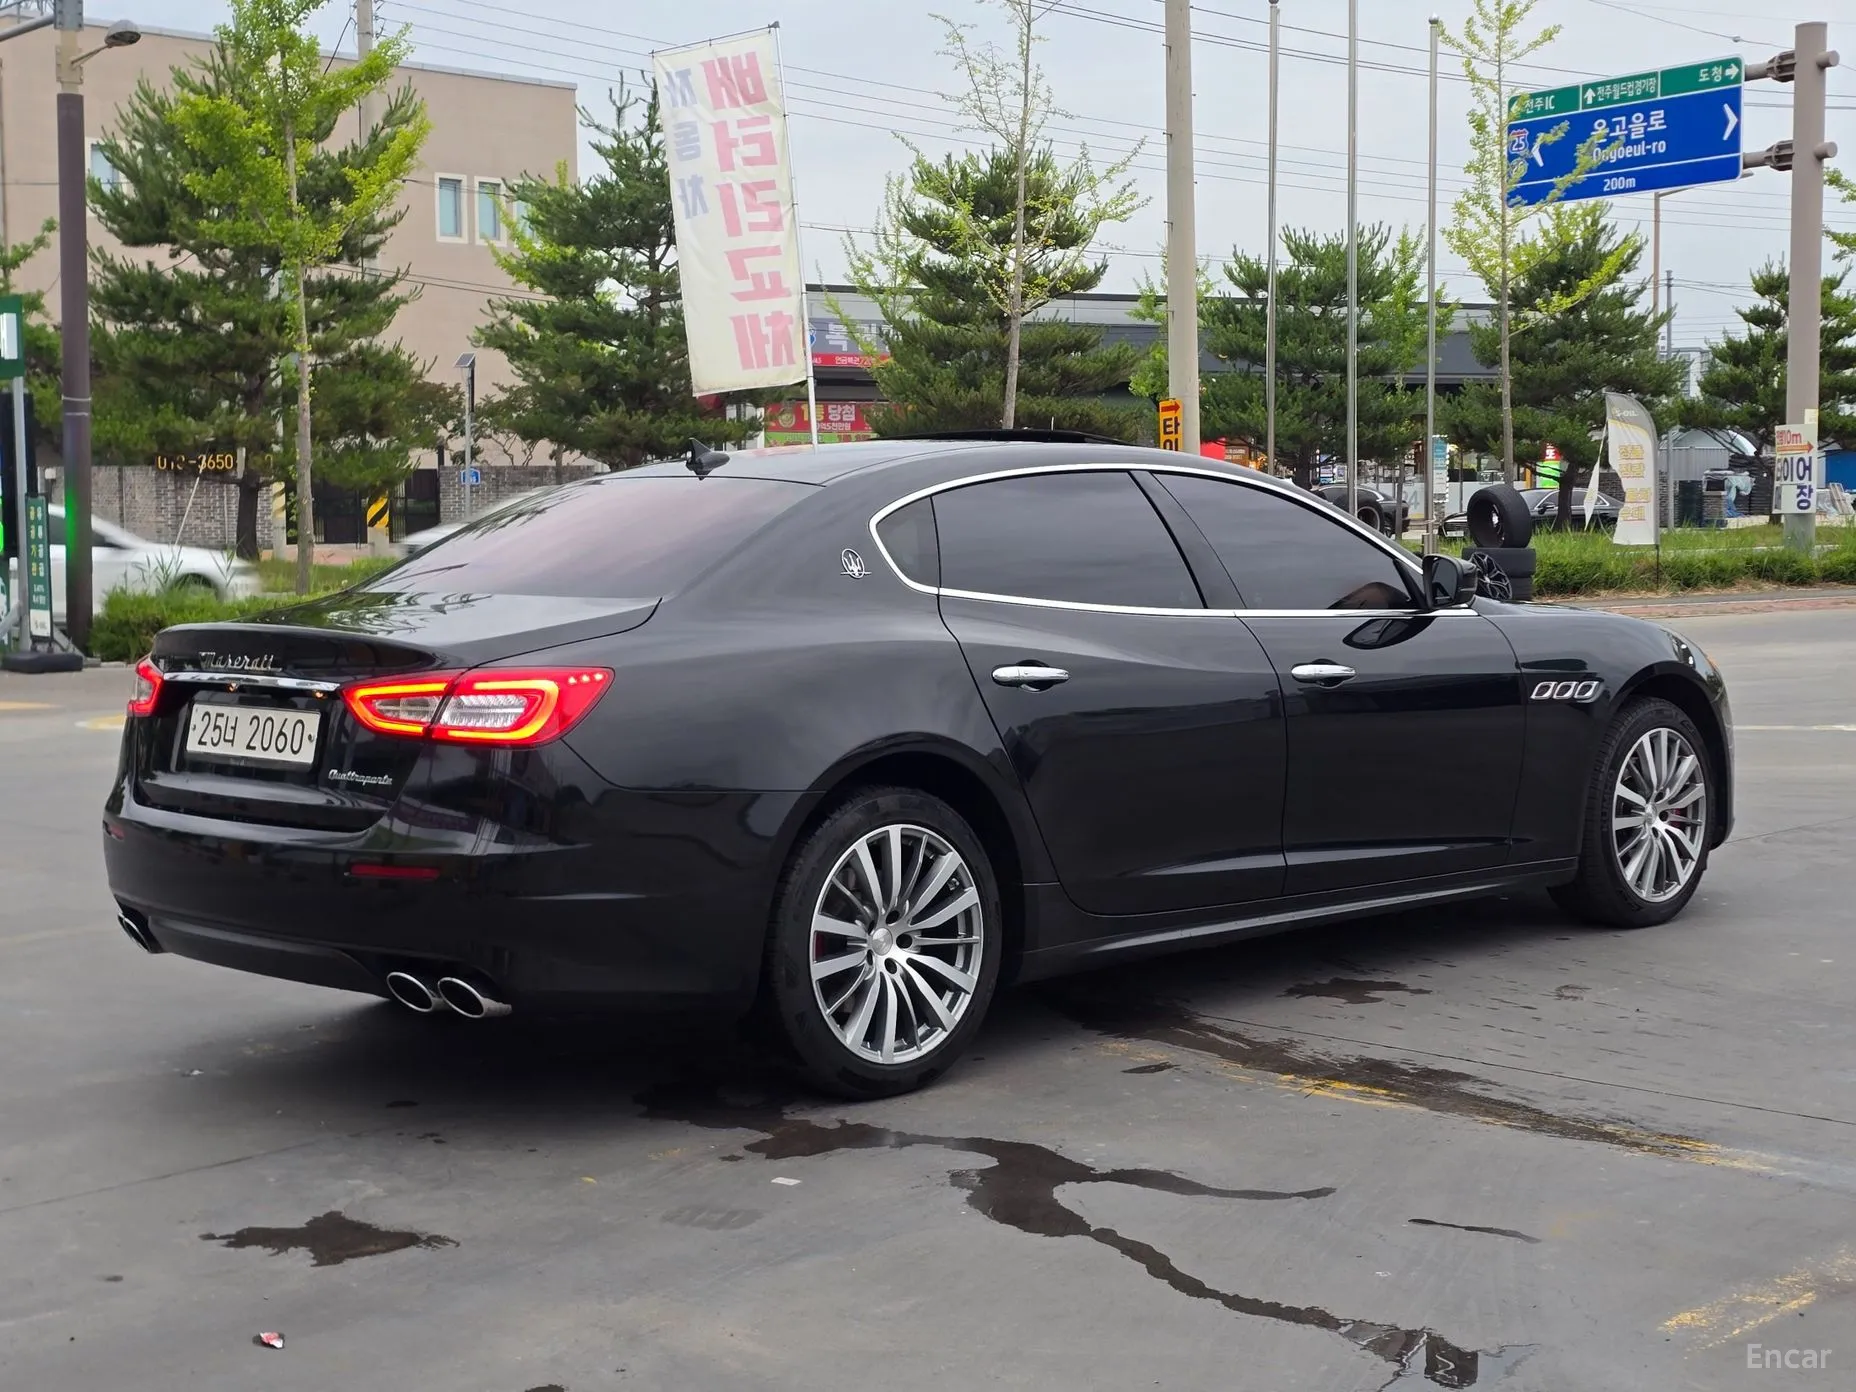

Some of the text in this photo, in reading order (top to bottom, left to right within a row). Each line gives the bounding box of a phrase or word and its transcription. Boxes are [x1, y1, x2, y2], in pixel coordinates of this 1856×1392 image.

[1698, 65, 1723, 82] 도청
[1596, 77, 1657, 102] 전주월드컵경기장
[1590, 109, 1667, 143] 온고을로
[1511, 136, 1526, 151] 25
[1603, 177, 1636, 191] 200m
[828, 404, 856, 422] 당첨
[199, 651, 283, 672] Maserati
[197, 711, 305, 755] 25너 2060
